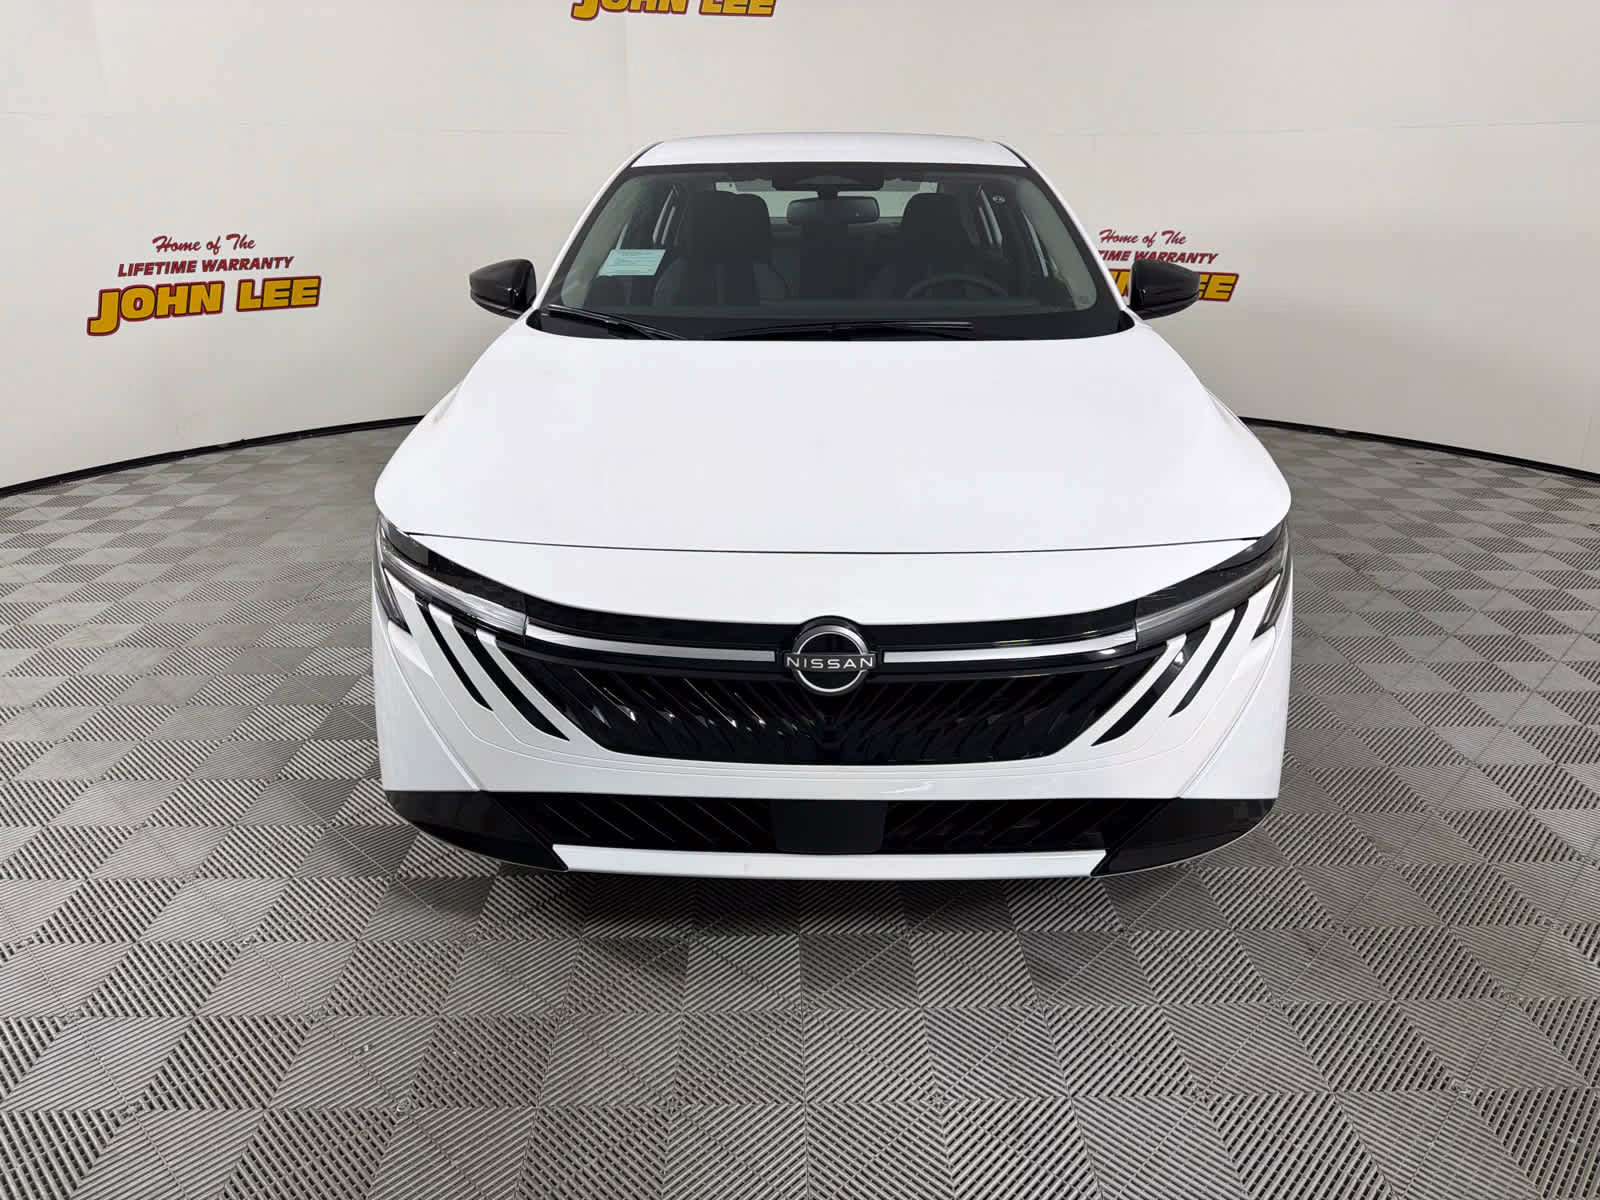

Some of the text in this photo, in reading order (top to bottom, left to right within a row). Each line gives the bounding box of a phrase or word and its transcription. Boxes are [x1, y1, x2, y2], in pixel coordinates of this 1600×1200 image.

[152, 233, 256, 255] Home of The
[1099, 229, 1187, 247] Home of The
[117, 256, 295, 277] LIFETIME WARRANTY
[1135, 251, 1219, 264] WARRANTY
[87, 276, 321, 336] JOHN LEE
[786, 657, 873, 669] NISSAN
